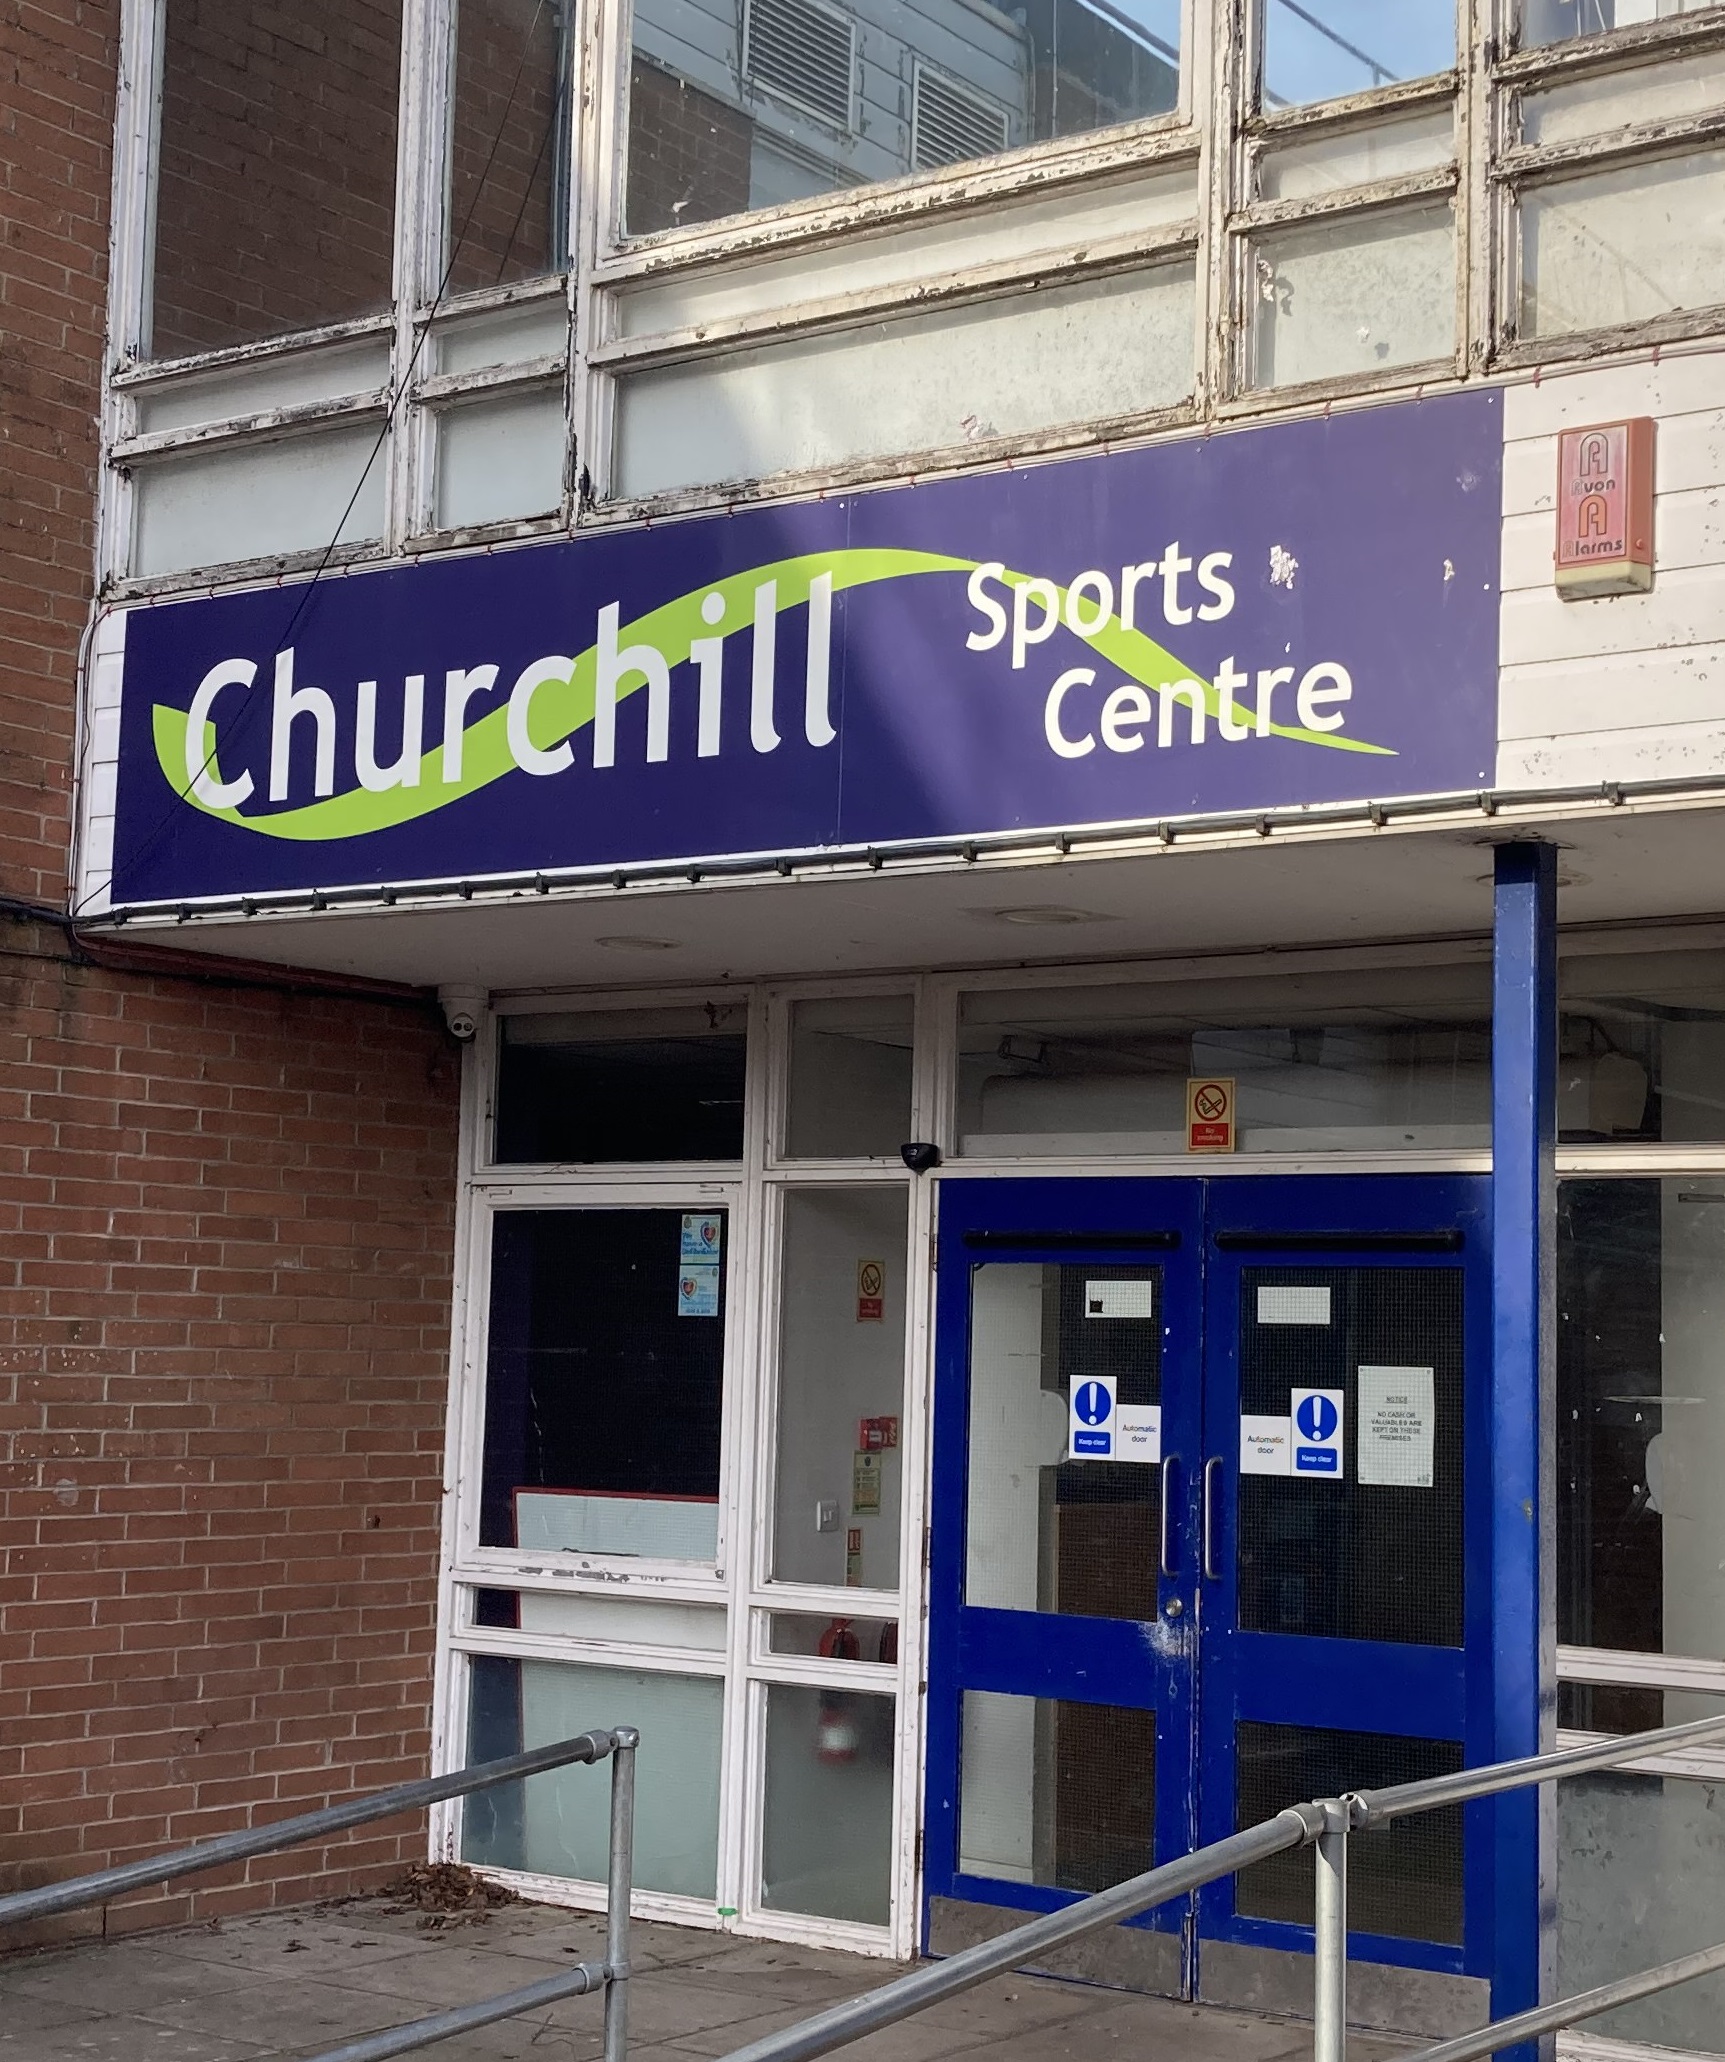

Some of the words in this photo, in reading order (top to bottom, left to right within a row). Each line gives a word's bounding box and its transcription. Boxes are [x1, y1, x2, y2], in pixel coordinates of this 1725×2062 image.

[1571, 477, 1616, 496] Avon
[1562, 539, 1623, 558] Alarms
[966, 541, 1235, 669] Sports
[185, 571, 837, 809] Churchill
[1045, 656, 1353, 758] Centre
[1386, 1396, 1408, 1404] NOTICE
[1387, 1411, 1405, 1419] CASH
[1122, 1424, 1157, 1433] Automatic
[1399, 1427, 1421, 1435] THESE
[1078, 1438, 1093, 1446] Keep
[1131, 1435, 1148, 1443] door
[1247, 1435, 1284, 1444] Automatic
[1301, 1454, 1317, 1463] Keep
